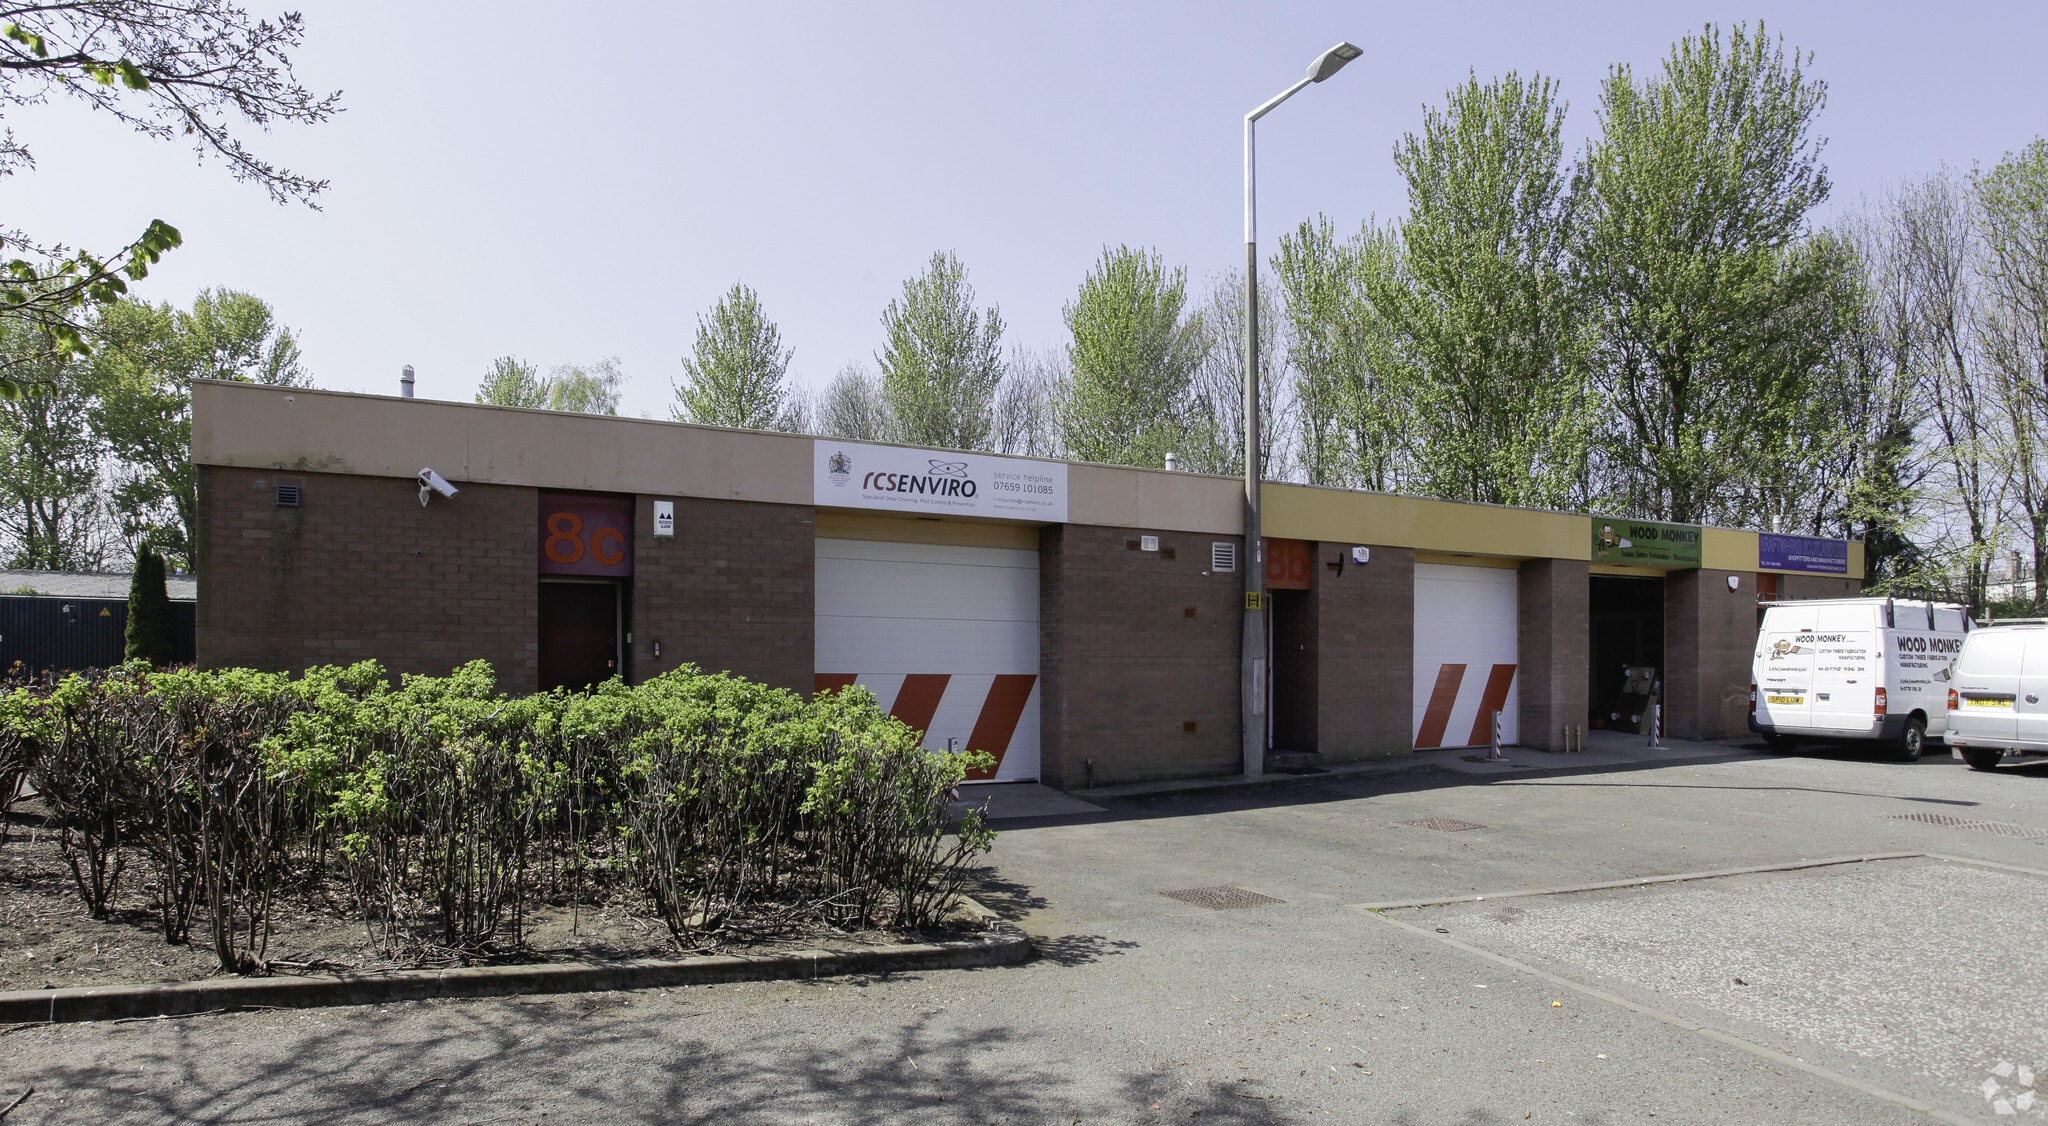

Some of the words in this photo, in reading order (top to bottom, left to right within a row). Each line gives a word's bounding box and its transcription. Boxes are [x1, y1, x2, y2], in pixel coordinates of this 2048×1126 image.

[993, 471, 1021, 481] service
[1023, 473, 1053, 484] helpline
[993, 481, 1020, 492] 07659
[1023, 484, 1053, 495] 101085
[544, 511, 625, 567] 8c
[1629, 525, 1658, 540] WOOD
[1661, 528, 1700, 544] MONKEY
[1795, 635, 1815, 643] WOOD
[1816, 634, 1846, 643] MONKEY
[1896, 636, 1927, 653] WOOD
